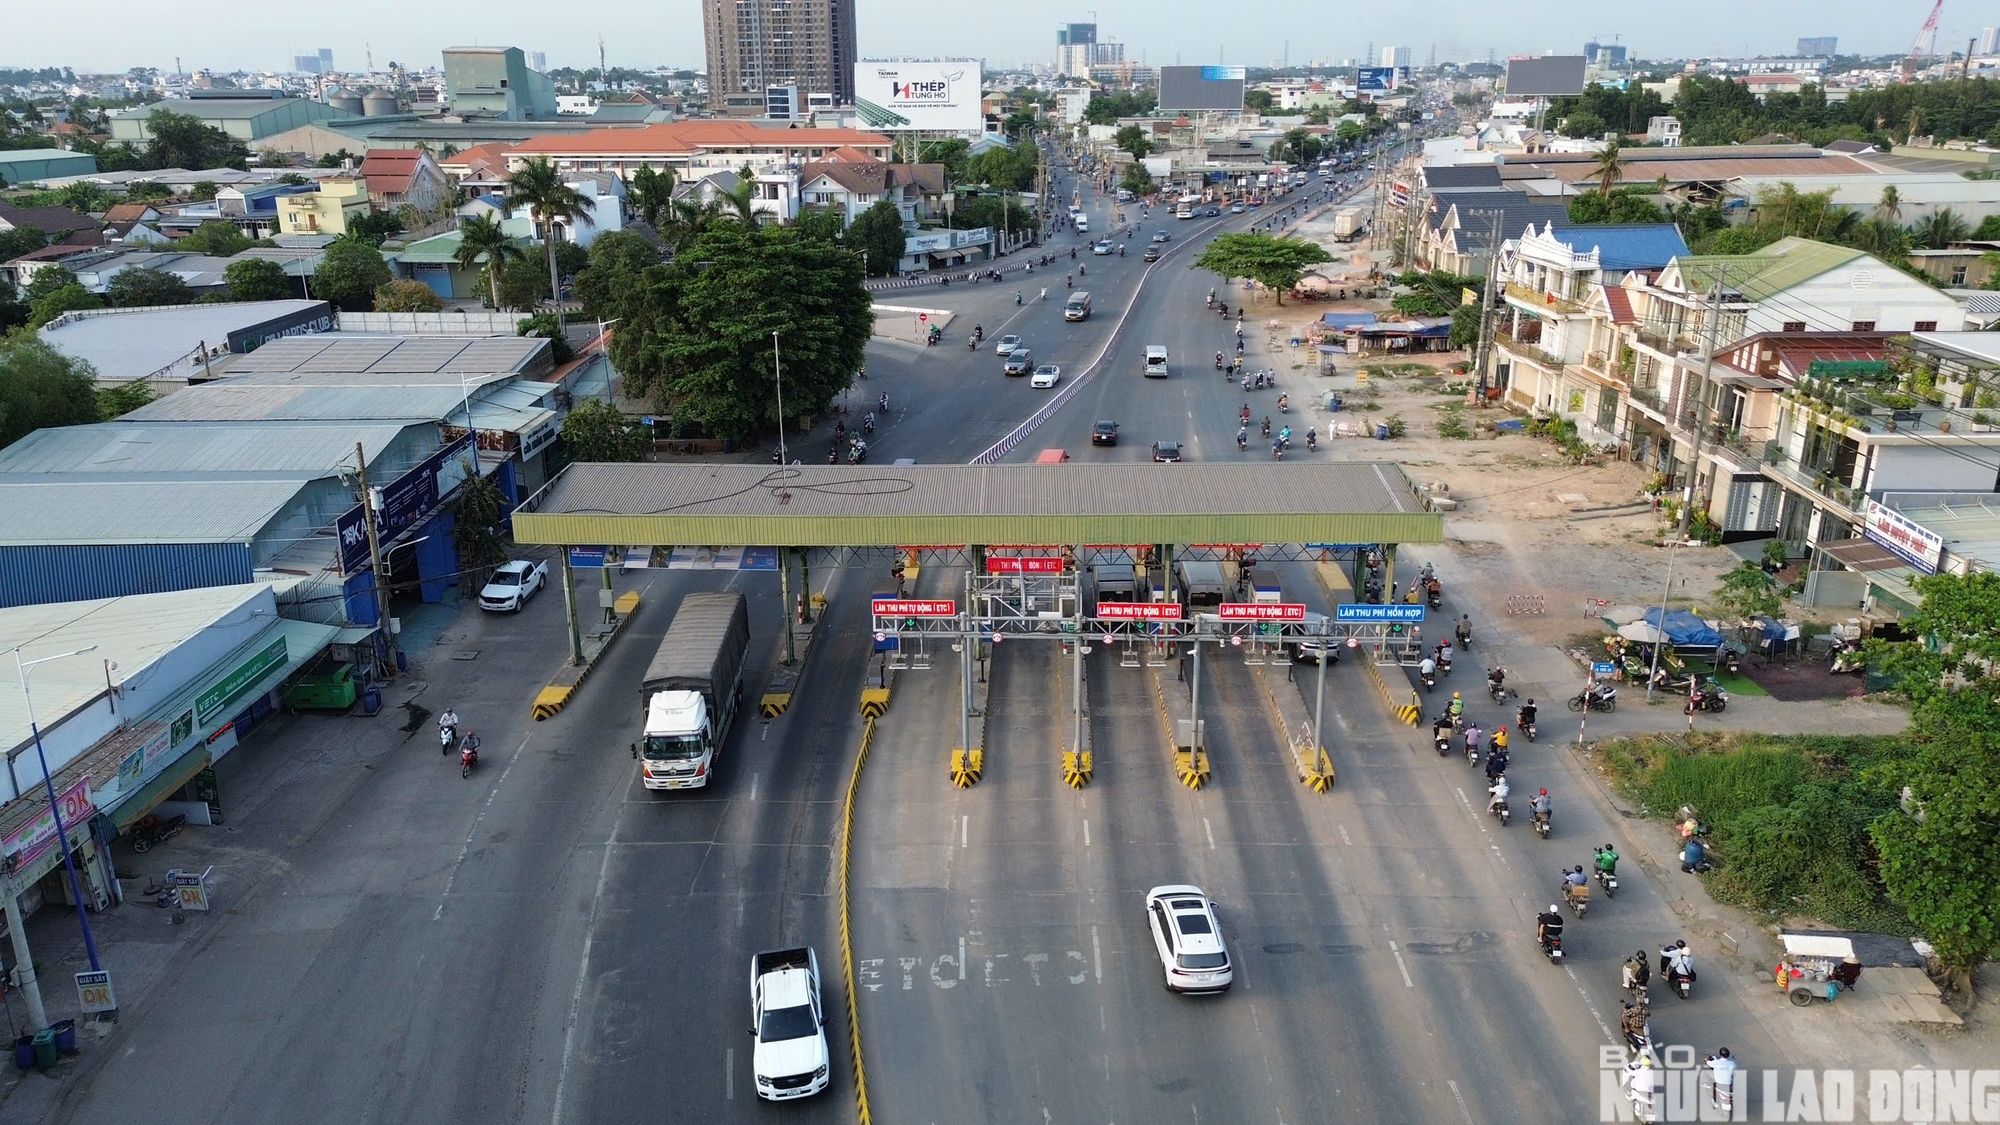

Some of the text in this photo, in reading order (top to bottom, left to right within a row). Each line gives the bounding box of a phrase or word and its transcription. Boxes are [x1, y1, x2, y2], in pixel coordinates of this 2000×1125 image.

[911, 80, 945, 92] THÉP
[308, 316, 330, 335] CLUB
[886, 604, 898, 612] THU
[1111, 606, 1122, 615] THU
[1234, 606, 1246, 615] THU
[1355, 608, 1370, 618] THU
[66, 786, 89, 820] OK
[181, 889, 203, 906] OK
[82, 987, 110, 1006] OK
